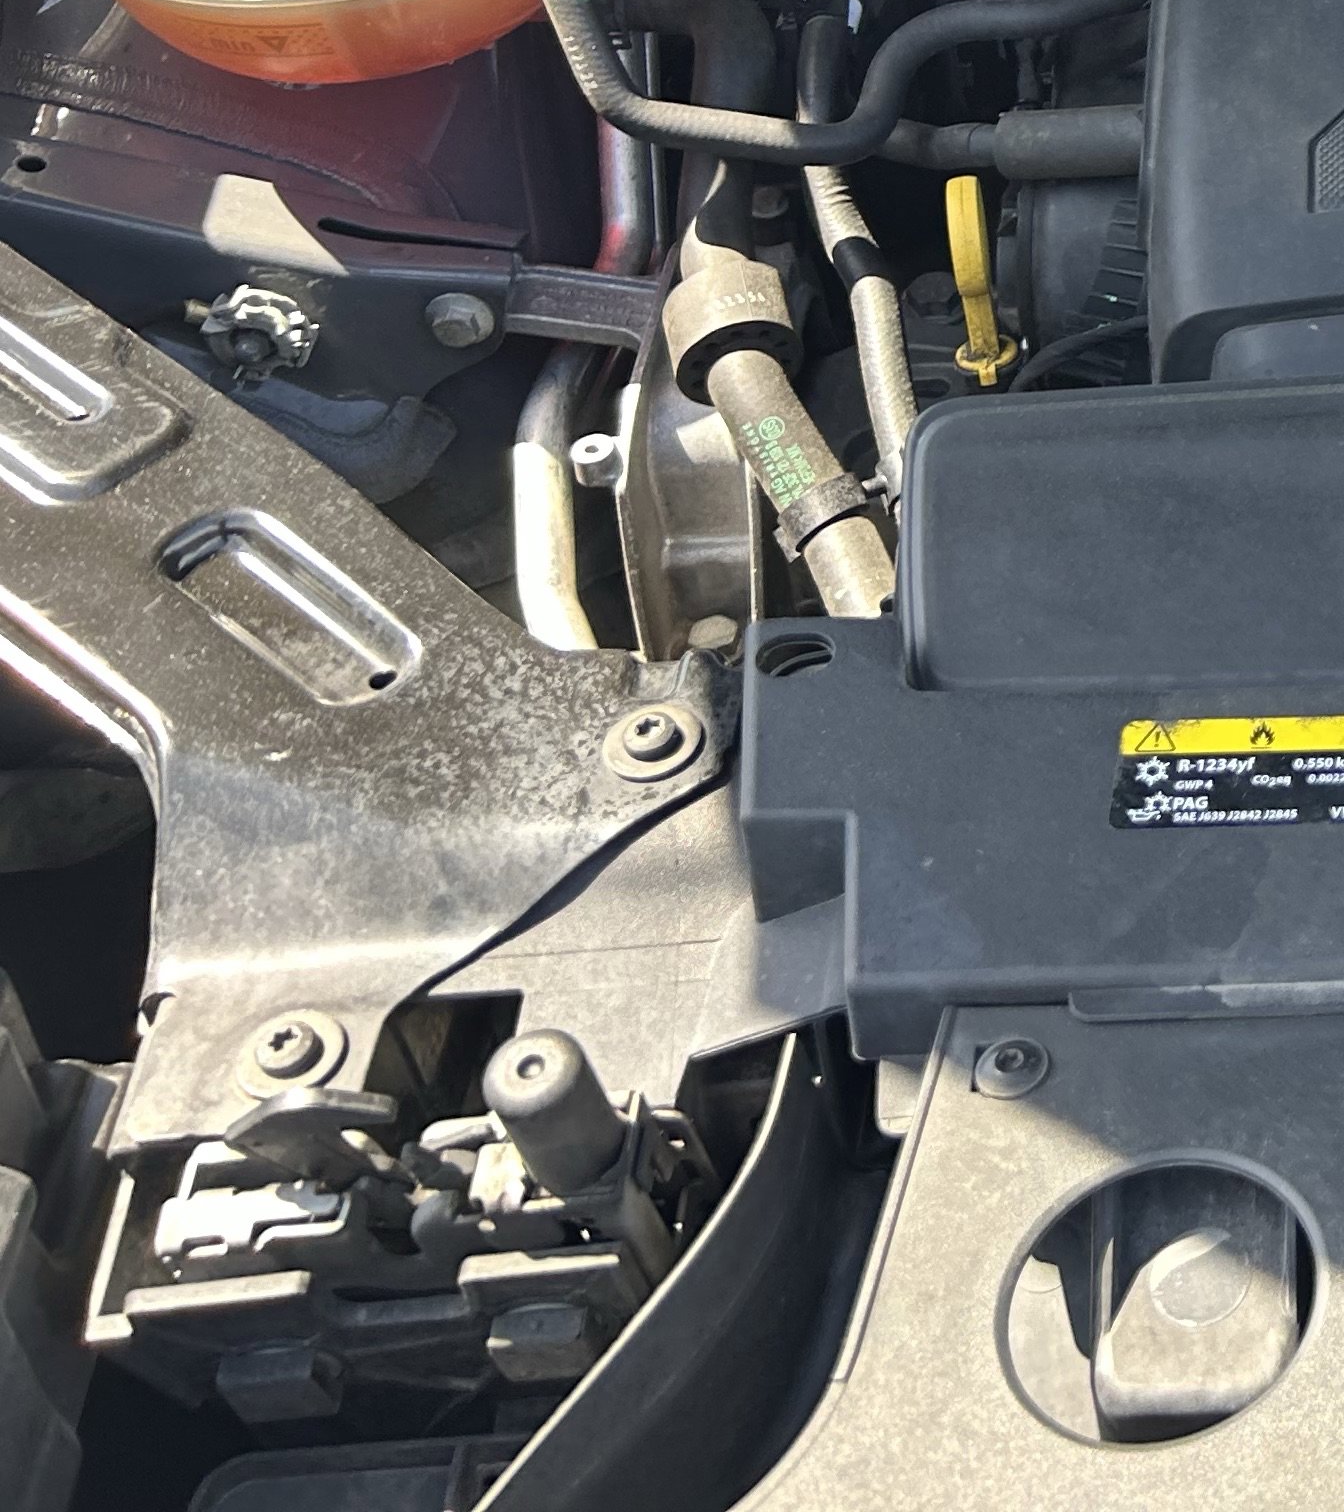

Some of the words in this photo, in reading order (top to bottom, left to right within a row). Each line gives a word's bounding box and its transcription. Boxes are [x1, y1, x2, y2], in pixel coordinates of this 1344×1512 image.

[1176, 757, 1256, 776] R-1234yf
[1175, 779, 1203, 791] GWP
[1172, 796, 1209, 810] PAG
[1172, 811, 1198, 823] SAE
[1198, 810, 1227, 823] J639
